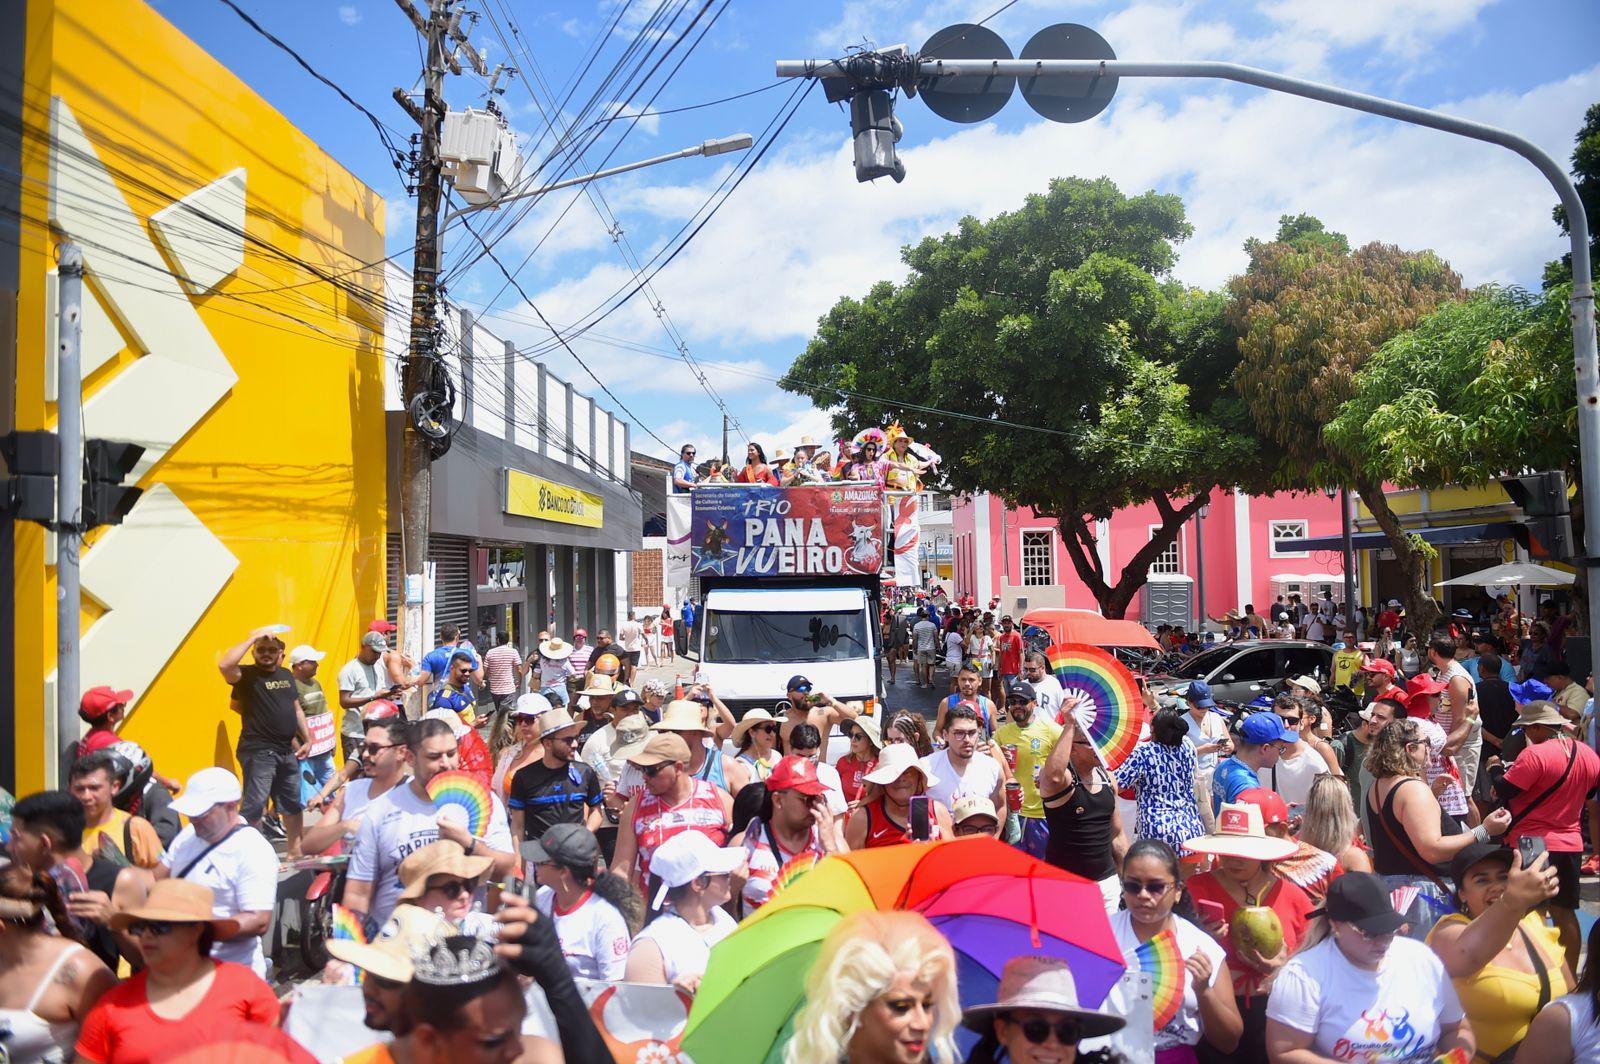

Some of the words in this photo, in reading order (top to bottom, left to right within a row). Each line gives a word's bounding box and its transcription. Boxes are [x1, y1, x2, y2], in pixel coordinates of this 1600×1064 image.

[845, 490, 879, 500] AMAZONAS
[745, 518, 829, 547] PANA
[735, 546, 843, 575] VUEIRO
[265, 680, 291, 690] BOSS
[1351, 1042, 1382, 1050] Circuito
[1381, 1041, 1393, 1049] do
